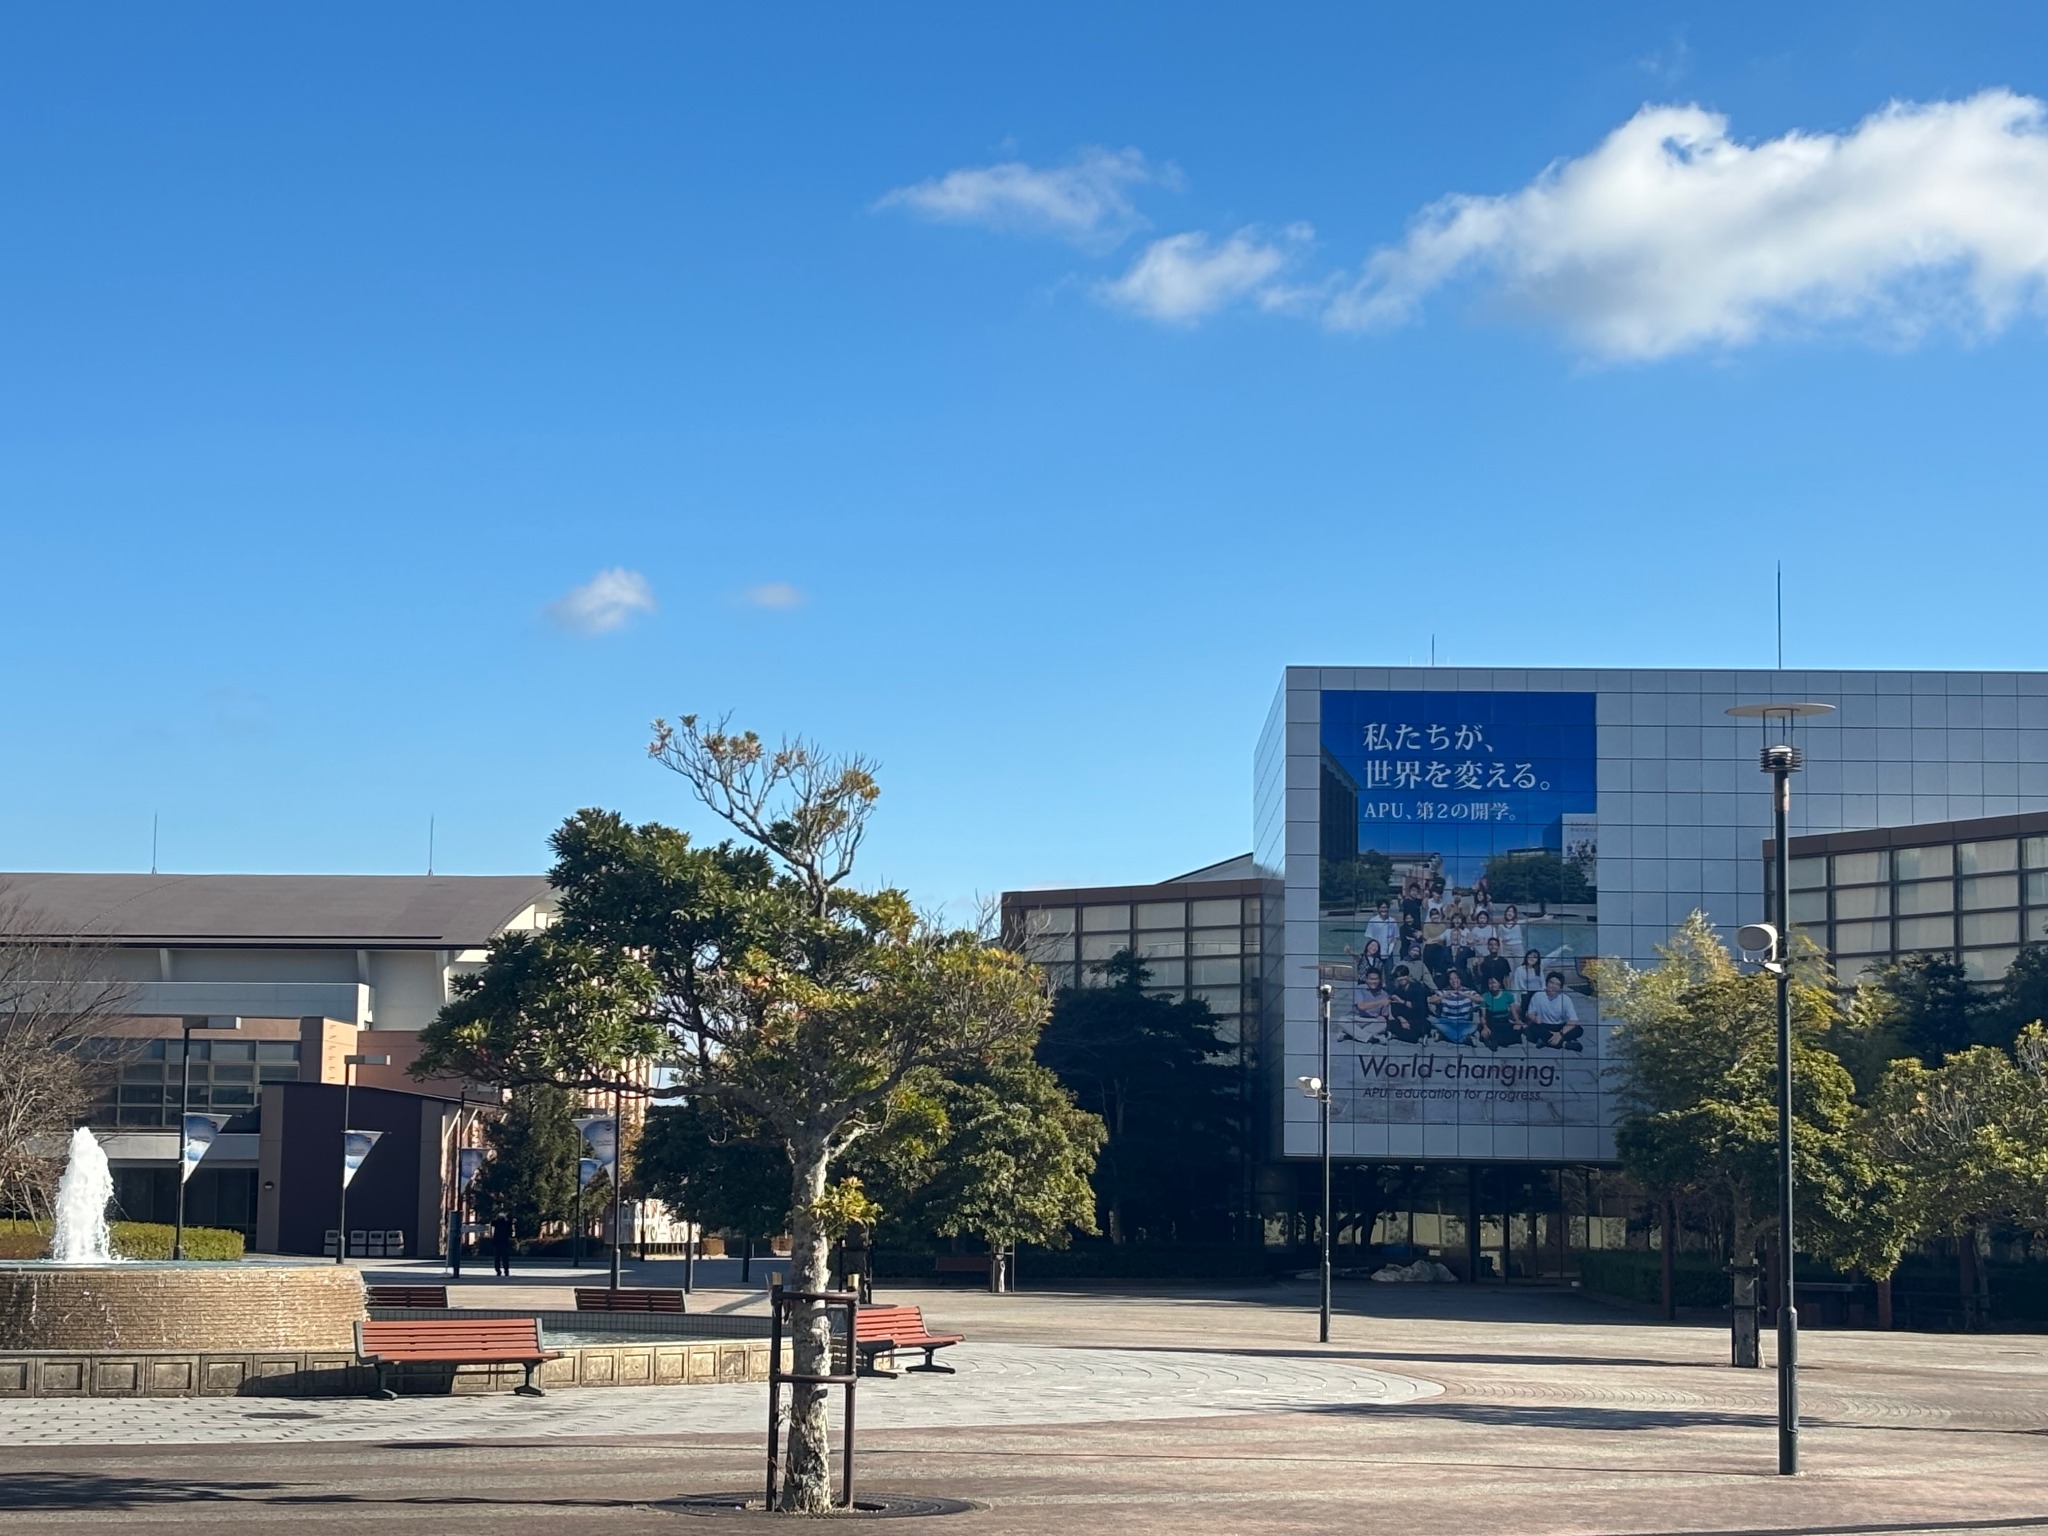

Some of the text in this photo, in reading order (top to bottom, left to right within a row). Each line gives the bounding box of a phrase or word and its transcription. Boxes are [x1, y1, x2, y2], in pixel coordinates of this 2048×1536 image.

[1362, 722, 1494, 752] 私たちが、
[1362, 760, 1551, 790] 世界を変える。
[1358, 1053, 1561, 1087] World-changing.
[1395, 1087, 1460, 1099] education
[1464, 1088, 1481, 1100] for
